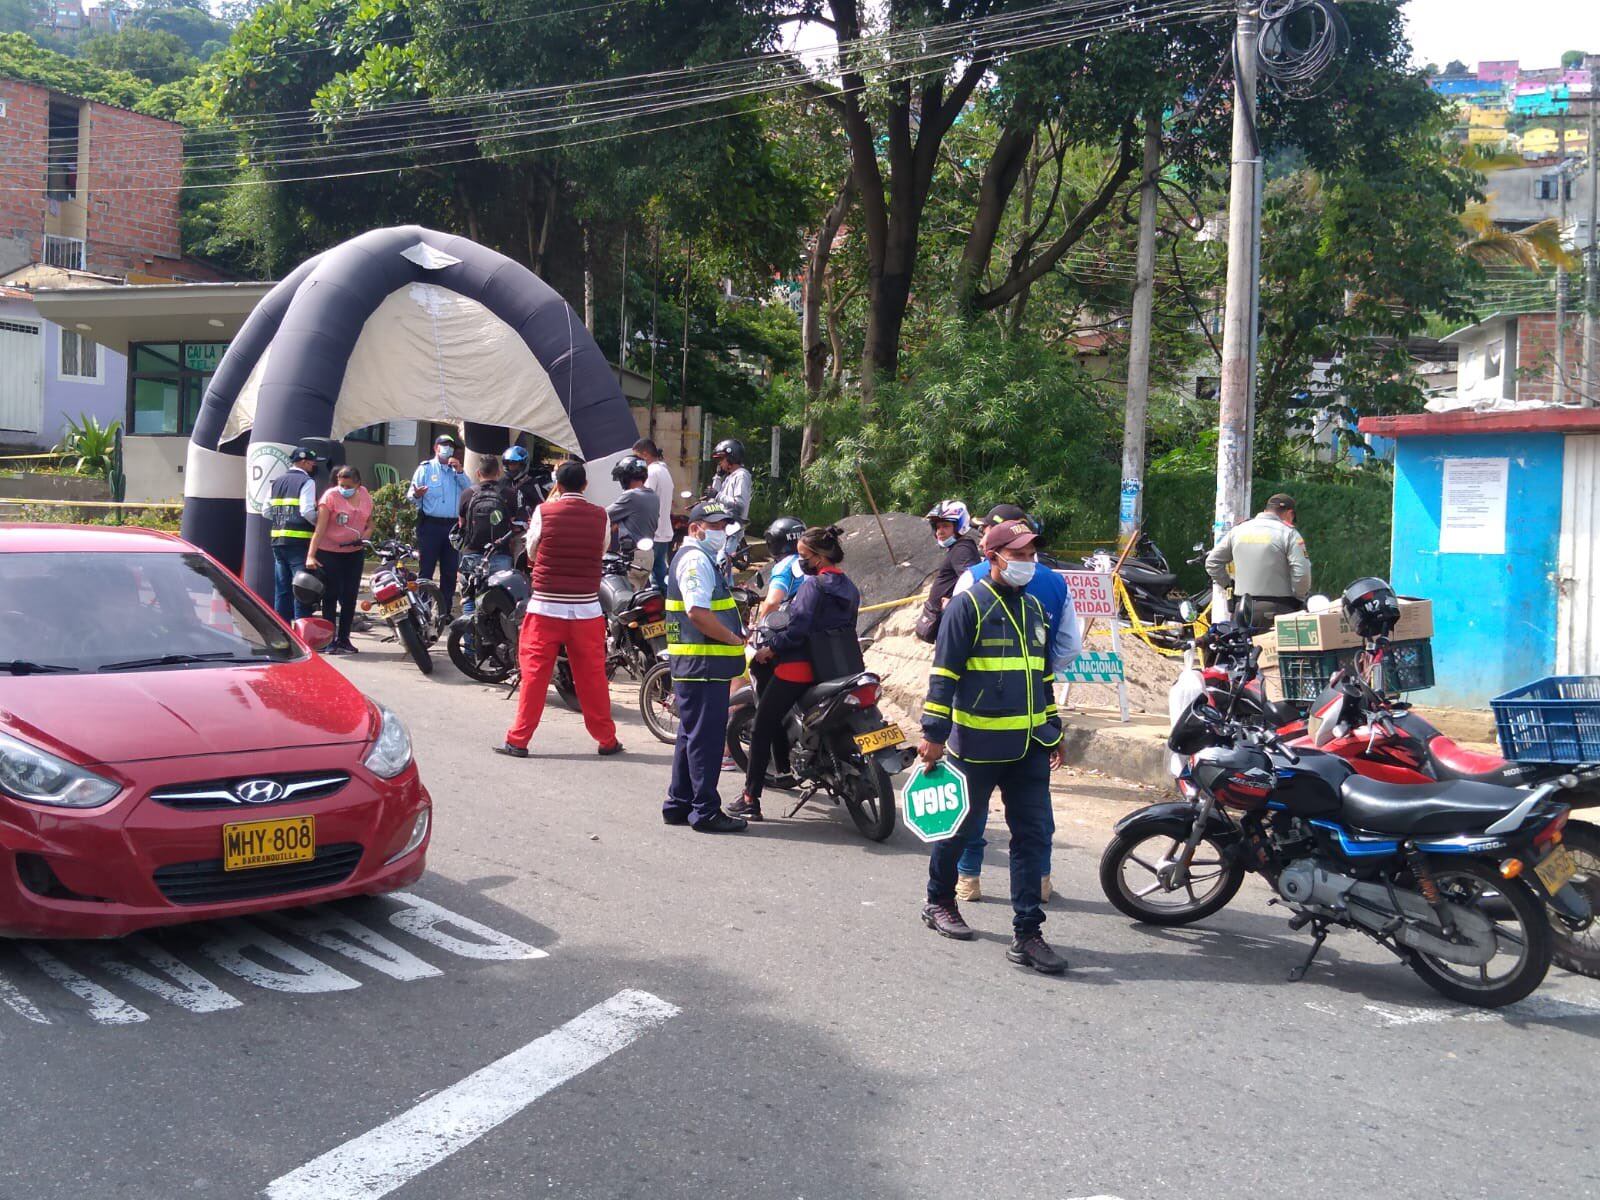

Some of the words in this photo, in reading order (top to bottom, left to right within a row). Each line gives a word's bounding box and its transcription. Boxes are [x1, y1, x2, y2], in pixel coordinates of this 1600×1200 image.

[204, 345, 216, 359] LA
[252, 465, 263, 481] D
[1063, 575, 1100, 588] ACIAS
[1071, 588, 1086, 600] OR
[1090, 588, 1106, 600] SU
[1074, 601, 1111, 613] RIDAD
[1080, 660, 1122, 674] NACIONAL
[1502, 765, 1537, 776] HONDA
[911, 782, 959, 817] SIGA
